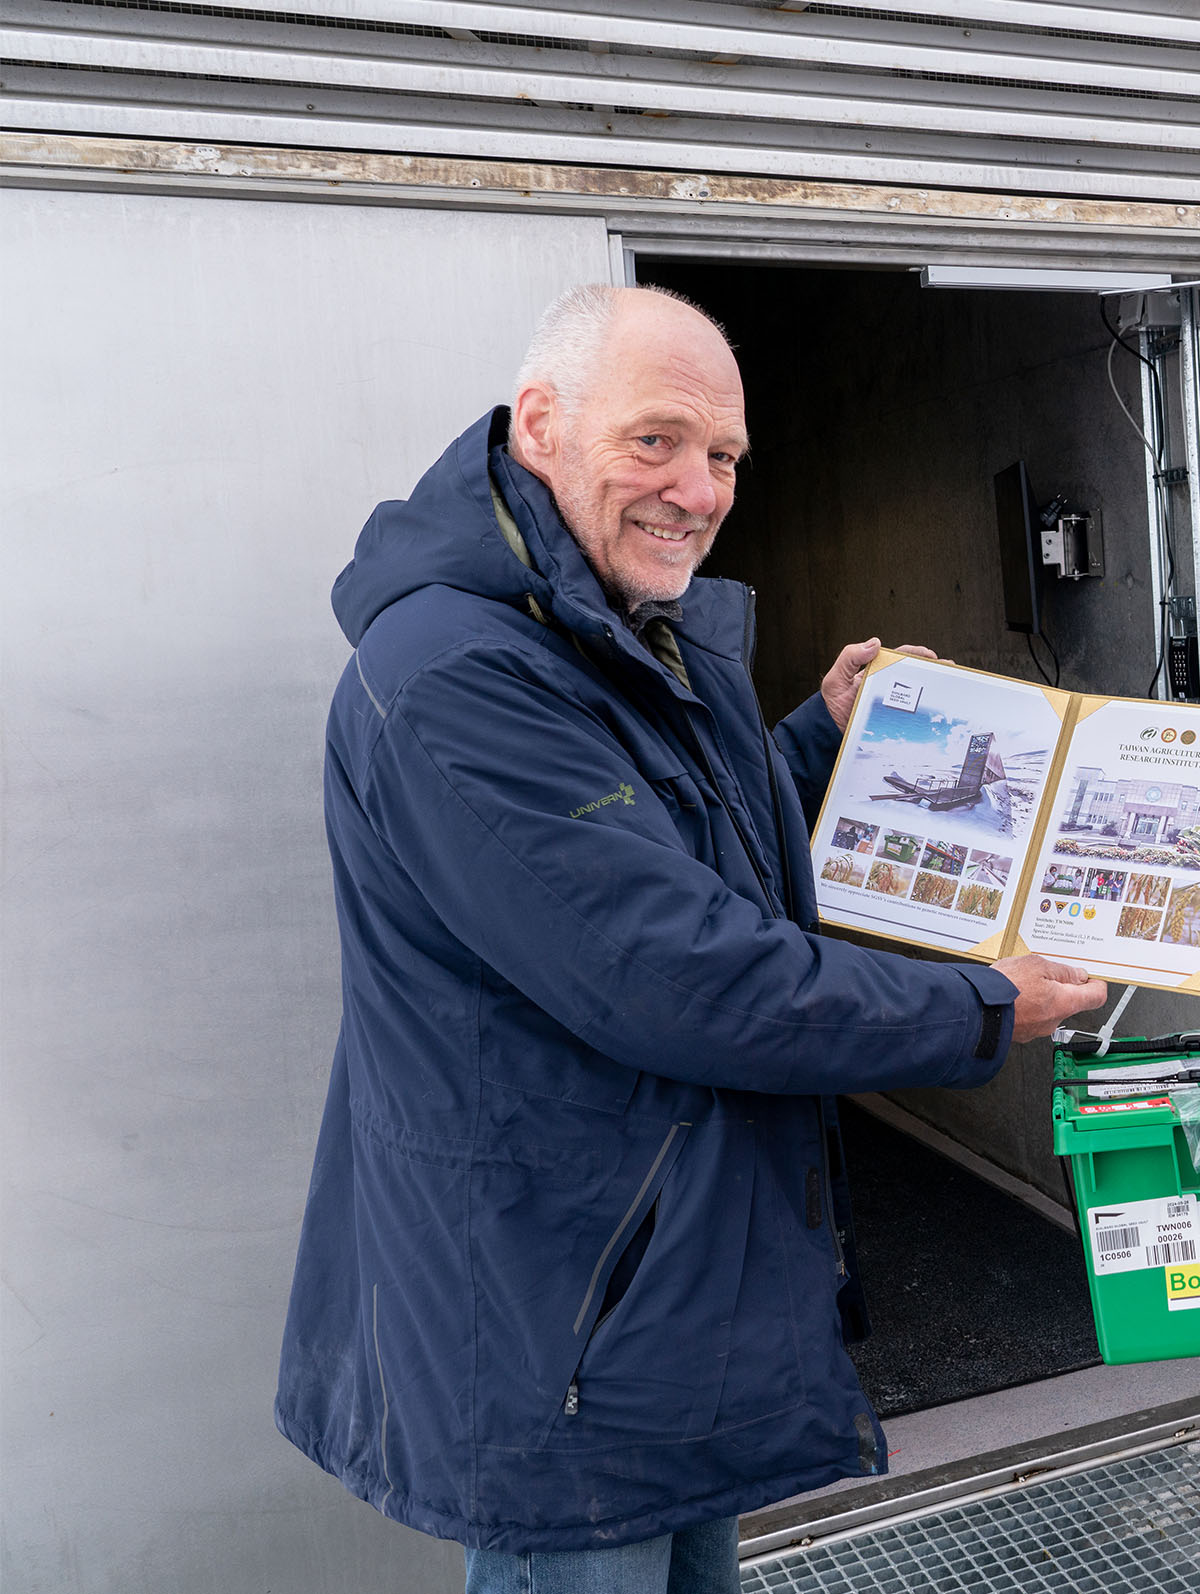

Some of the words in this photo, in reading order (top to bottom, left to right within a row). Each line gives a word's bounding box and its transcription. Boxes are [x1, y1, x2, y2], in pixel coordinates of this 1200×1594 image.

[1119, 744, 1149, 753] TAIWAN
[1120, 754, 1160, 764] RESEARCH
[570, 791, 623, 819] UNIVERN
[1156, 1220, 1192, 1233] TWN006
[1157, 1232, 1183, 1243] 00026
[1100, 1250, 1132, 1261] 1C0506
